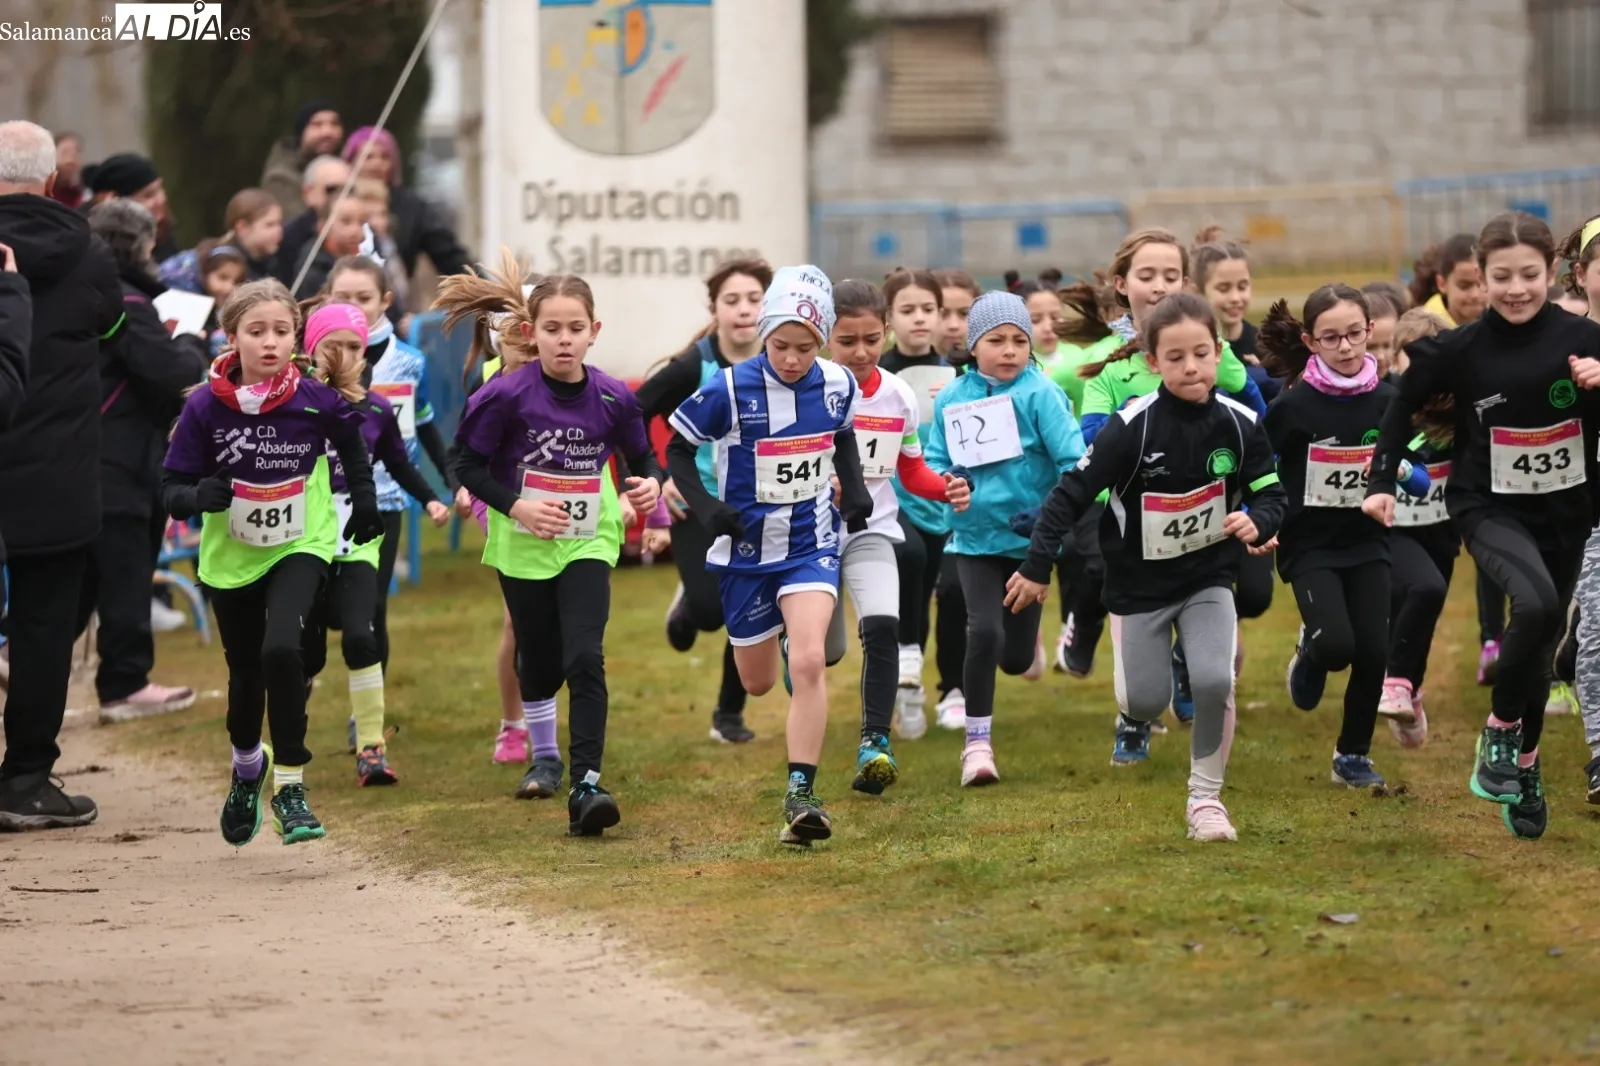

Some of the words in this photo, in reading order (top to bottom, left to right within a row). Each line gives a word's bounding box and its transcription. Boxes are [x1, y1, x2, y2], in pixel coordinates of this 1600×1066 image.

[952, 415, 998, 451] 72
[256, 441, 312, 455] Abadengo
[1512, 447, 1571, 475] 433
[255, 457, 300, 471] Running
[776, 456, 822, 485] 541
[246, 503, 292, 529] 481
[1162, 506, 1214, 540] 427
